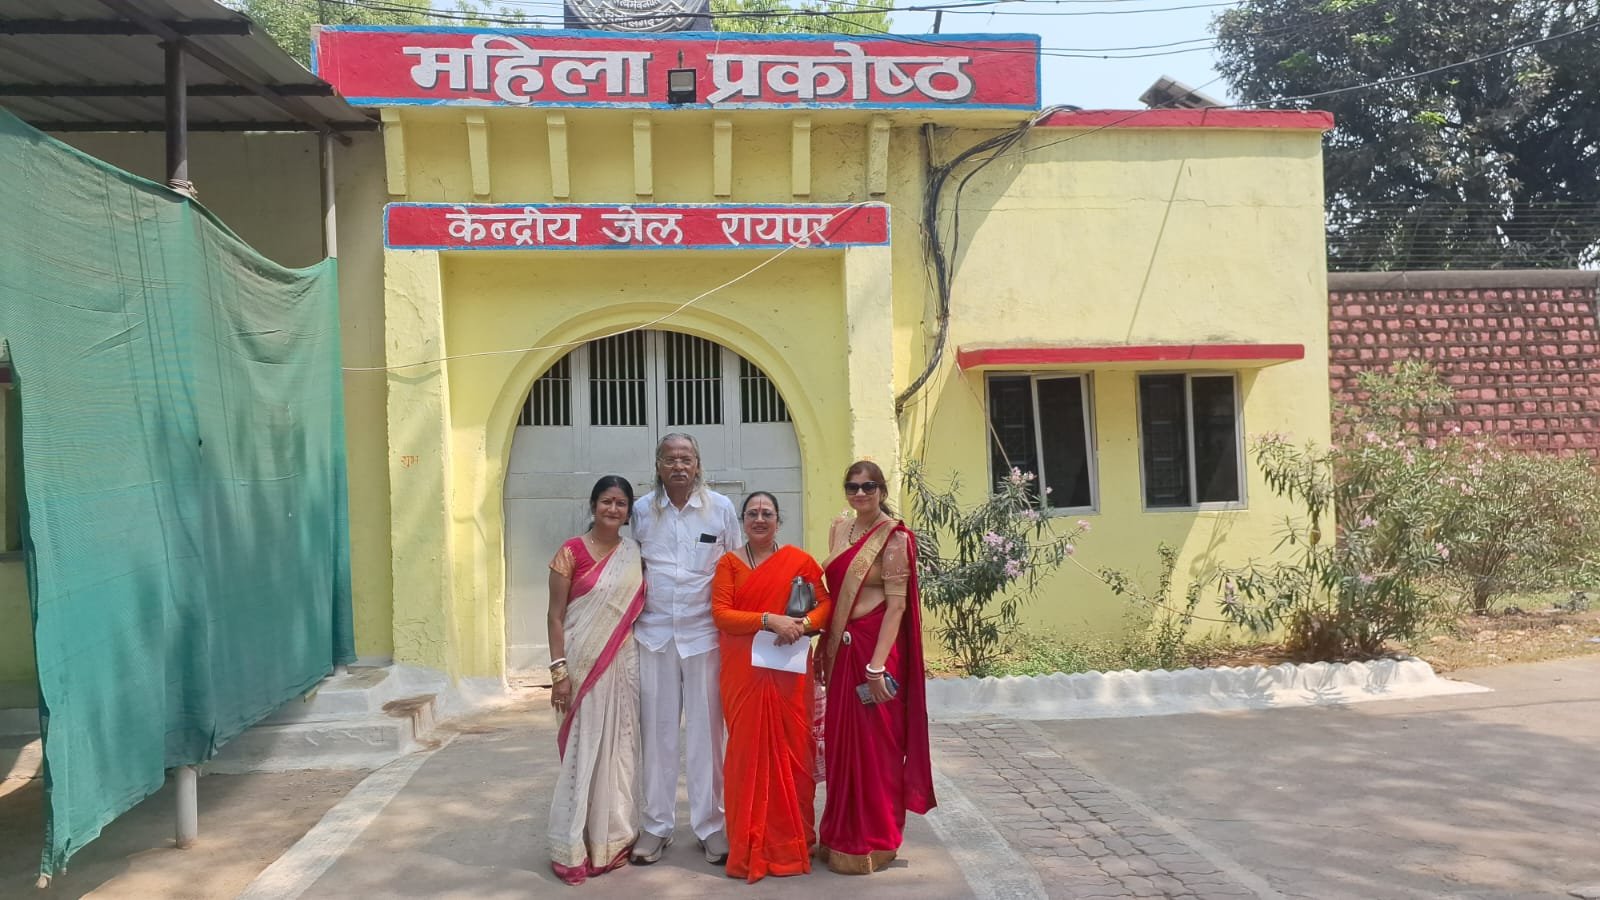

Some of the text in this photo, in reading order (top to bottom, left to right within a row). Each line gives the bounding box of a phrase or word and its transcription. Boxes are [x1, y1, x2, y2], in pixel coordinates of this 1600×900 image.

[402, 34, 973, 104] महिला प्रकोष्ठ
[446, 206, 834, 248] केन्द्रीय जेल रायपुर
